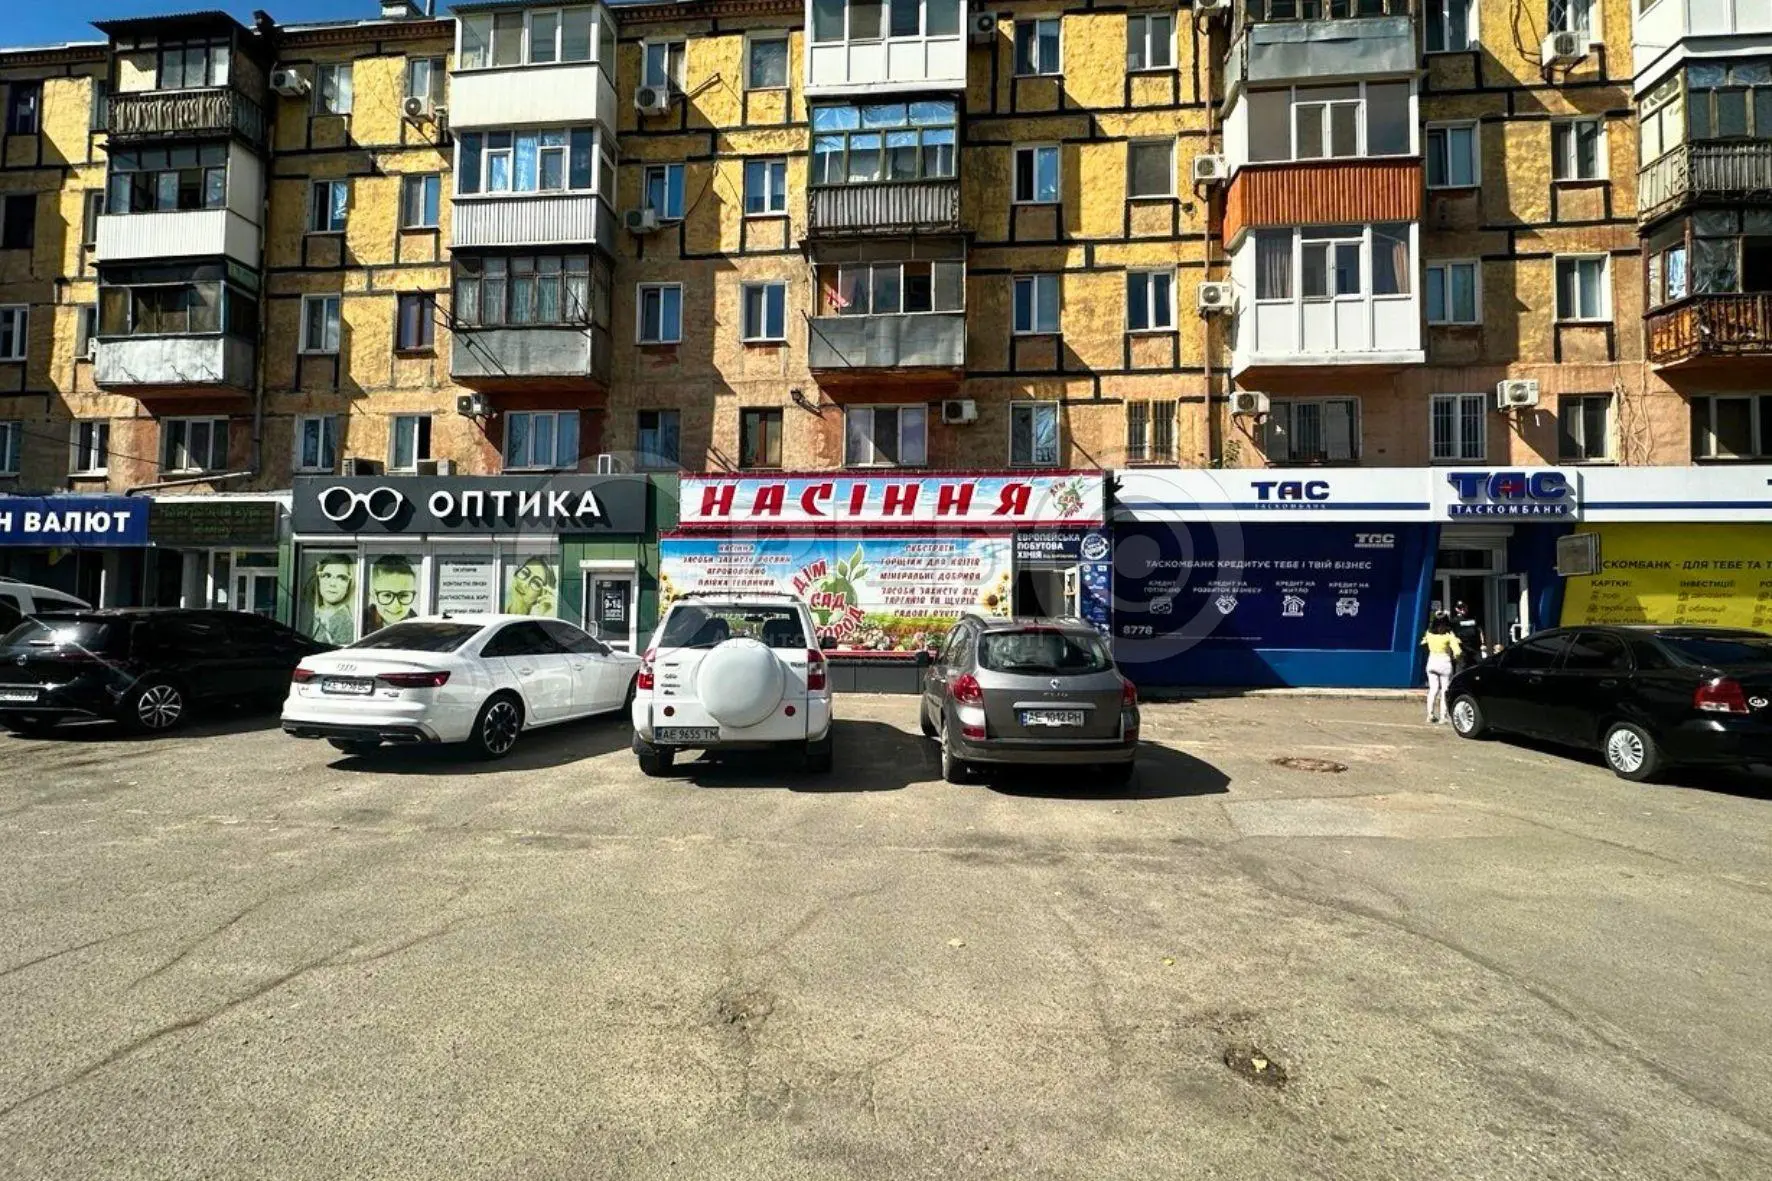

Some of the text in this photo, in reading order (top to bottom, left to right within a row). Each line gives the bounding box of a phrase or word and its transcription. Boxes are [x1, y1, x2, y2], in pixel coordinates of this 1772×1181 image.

[700, 482, 1033, 517] НАСІННЯ
[1250, 481, 1330, 500] ТАС
[428, 490, 602, 518] ОПТИКА
[1455, 504, 1563, 514] ТАСКОМБАНК
[24, 511, 131, 533] ВАЛЮТ
[1016, 542, 1064, 550] ПОБУТОВА
[1145, 560, 1215, 568] ТАСКОМБАНК
[1217, 560, 1271, 569] КРЕДИТУЄ
[1308, 560, 1333, 569] ТВІЙ
[1334, 561, 1372, 569] БІЗНЕС
[1601, 560, 1672, 569] СКОМБАНК
[1682, 560, 1708, 570] ДЛЯ
[1713, 561, 1742, 569] ТЕБЕ
[1747, 561, 1761, 569] ТА
[792, 559, 826, 596] ДІМ
[810, 592, 846, 612] САД
